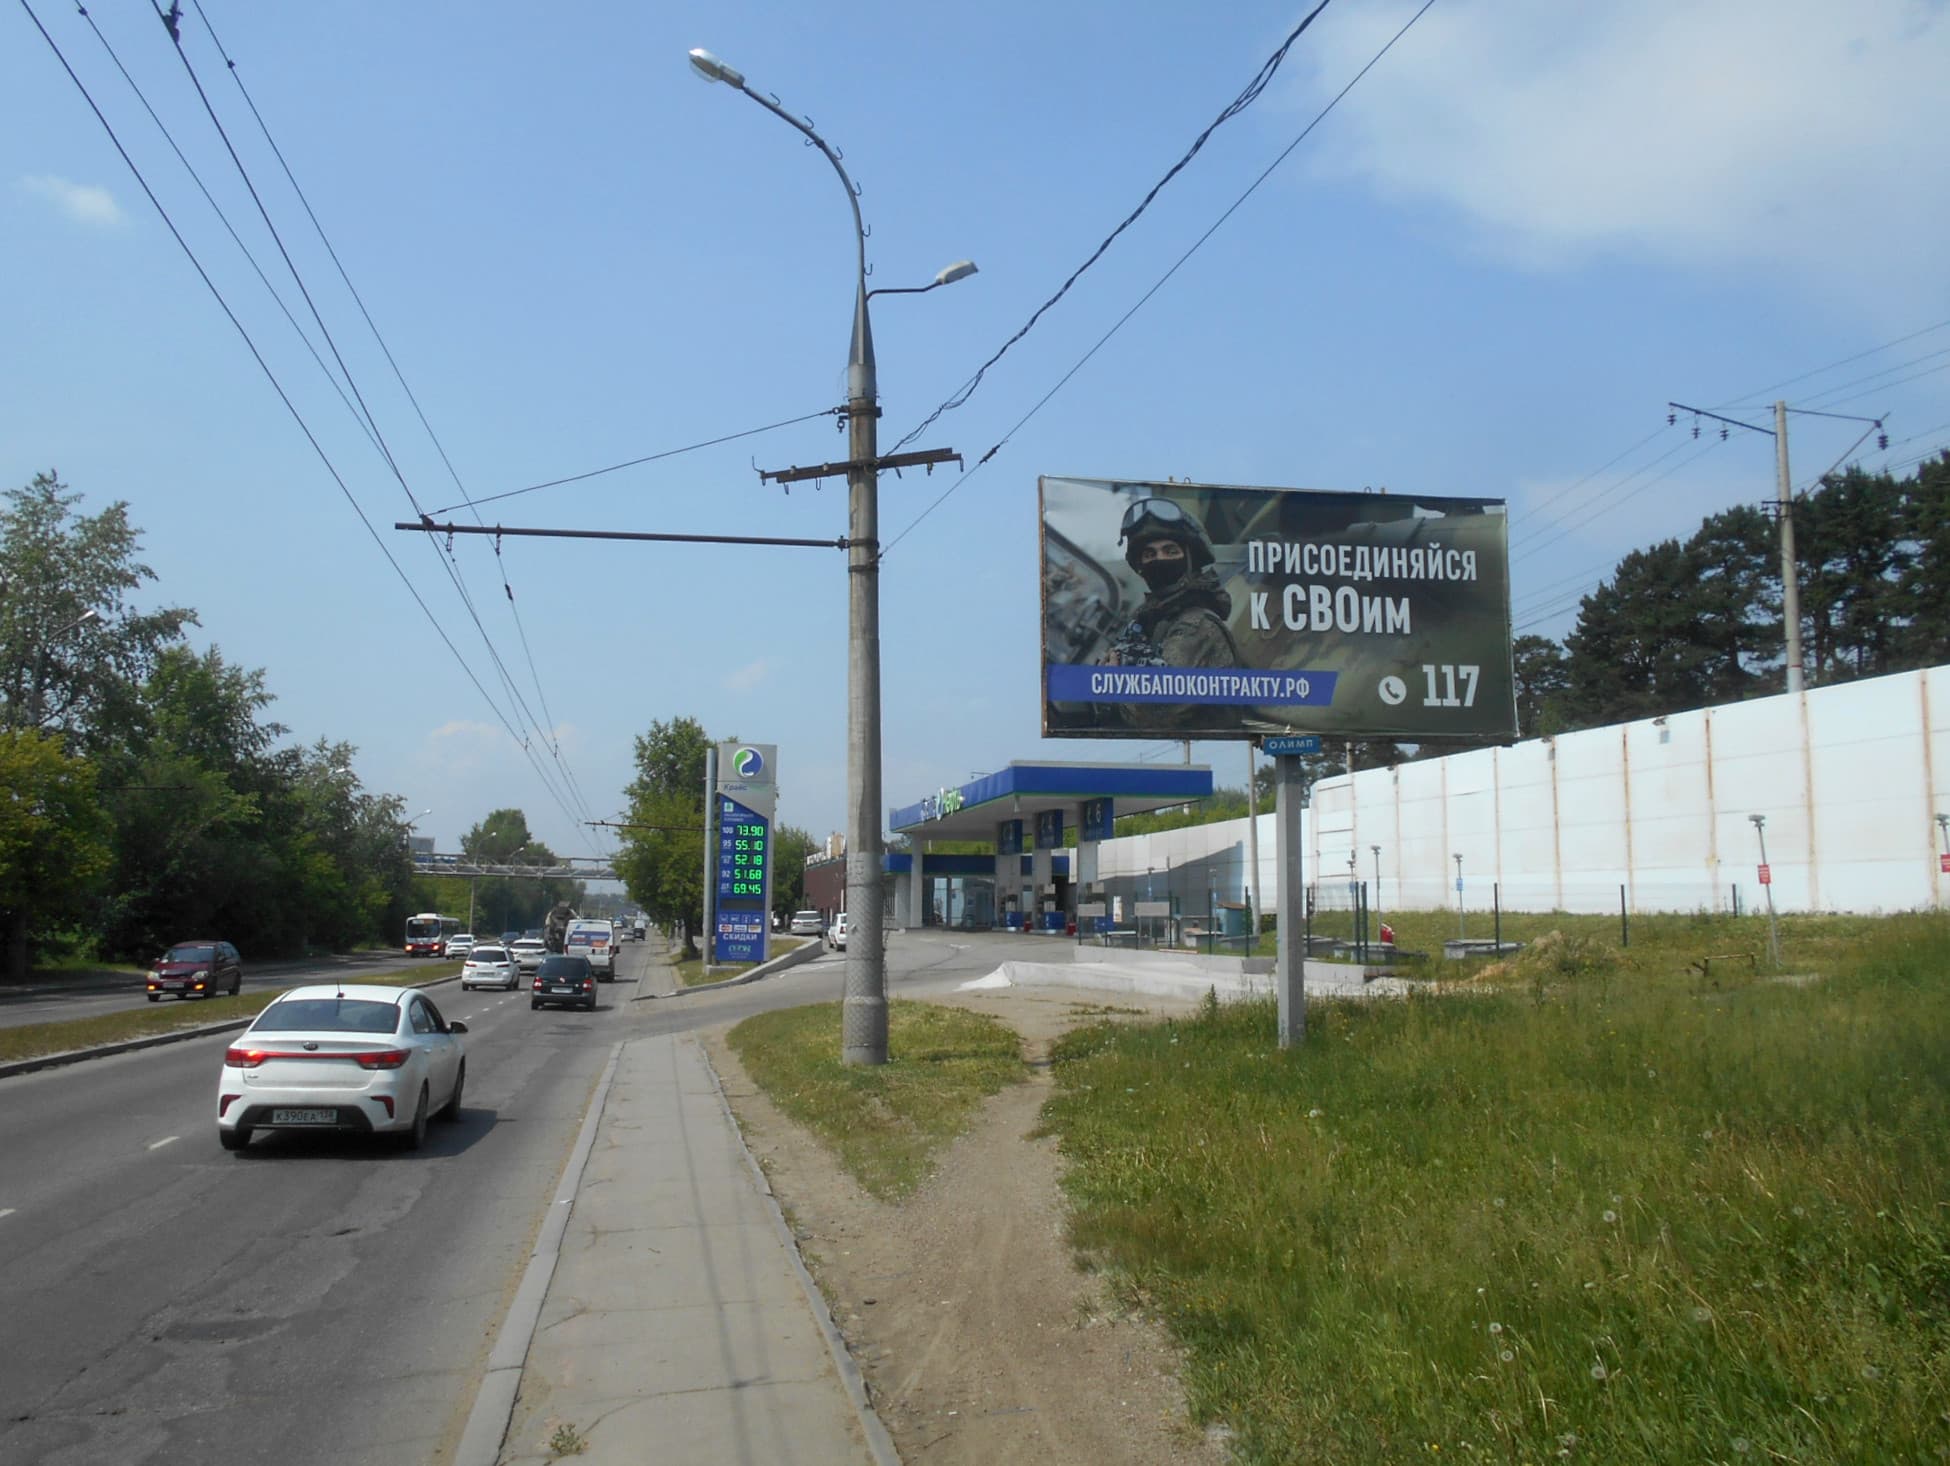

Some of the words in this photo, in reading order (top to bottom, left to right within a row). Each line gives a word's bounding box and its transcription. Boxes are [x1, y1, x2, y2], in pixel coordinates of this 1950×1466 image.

[1248, 541, 1477, 581] ПРИСОЕДИНЯЙСЯ
[1250, 592, 1270, 630] К
[1091, 672, 1310, 699] СЛУЖБАПОКОНТРАКТУ.РФ
[1422, 664, 1480, 707] 117
[1268, 739, 1313, 750] ОЛИМП
[736, 824, 764, 836] 73.90
[735, 839, 764, 850] 55.10
[734, 854, 763, 865] 52.18
[734, 868, 762, 880] 51.68
[733, 883, 761, 894] 69.45
[722, 933, 758, 941] СКИДКИ
